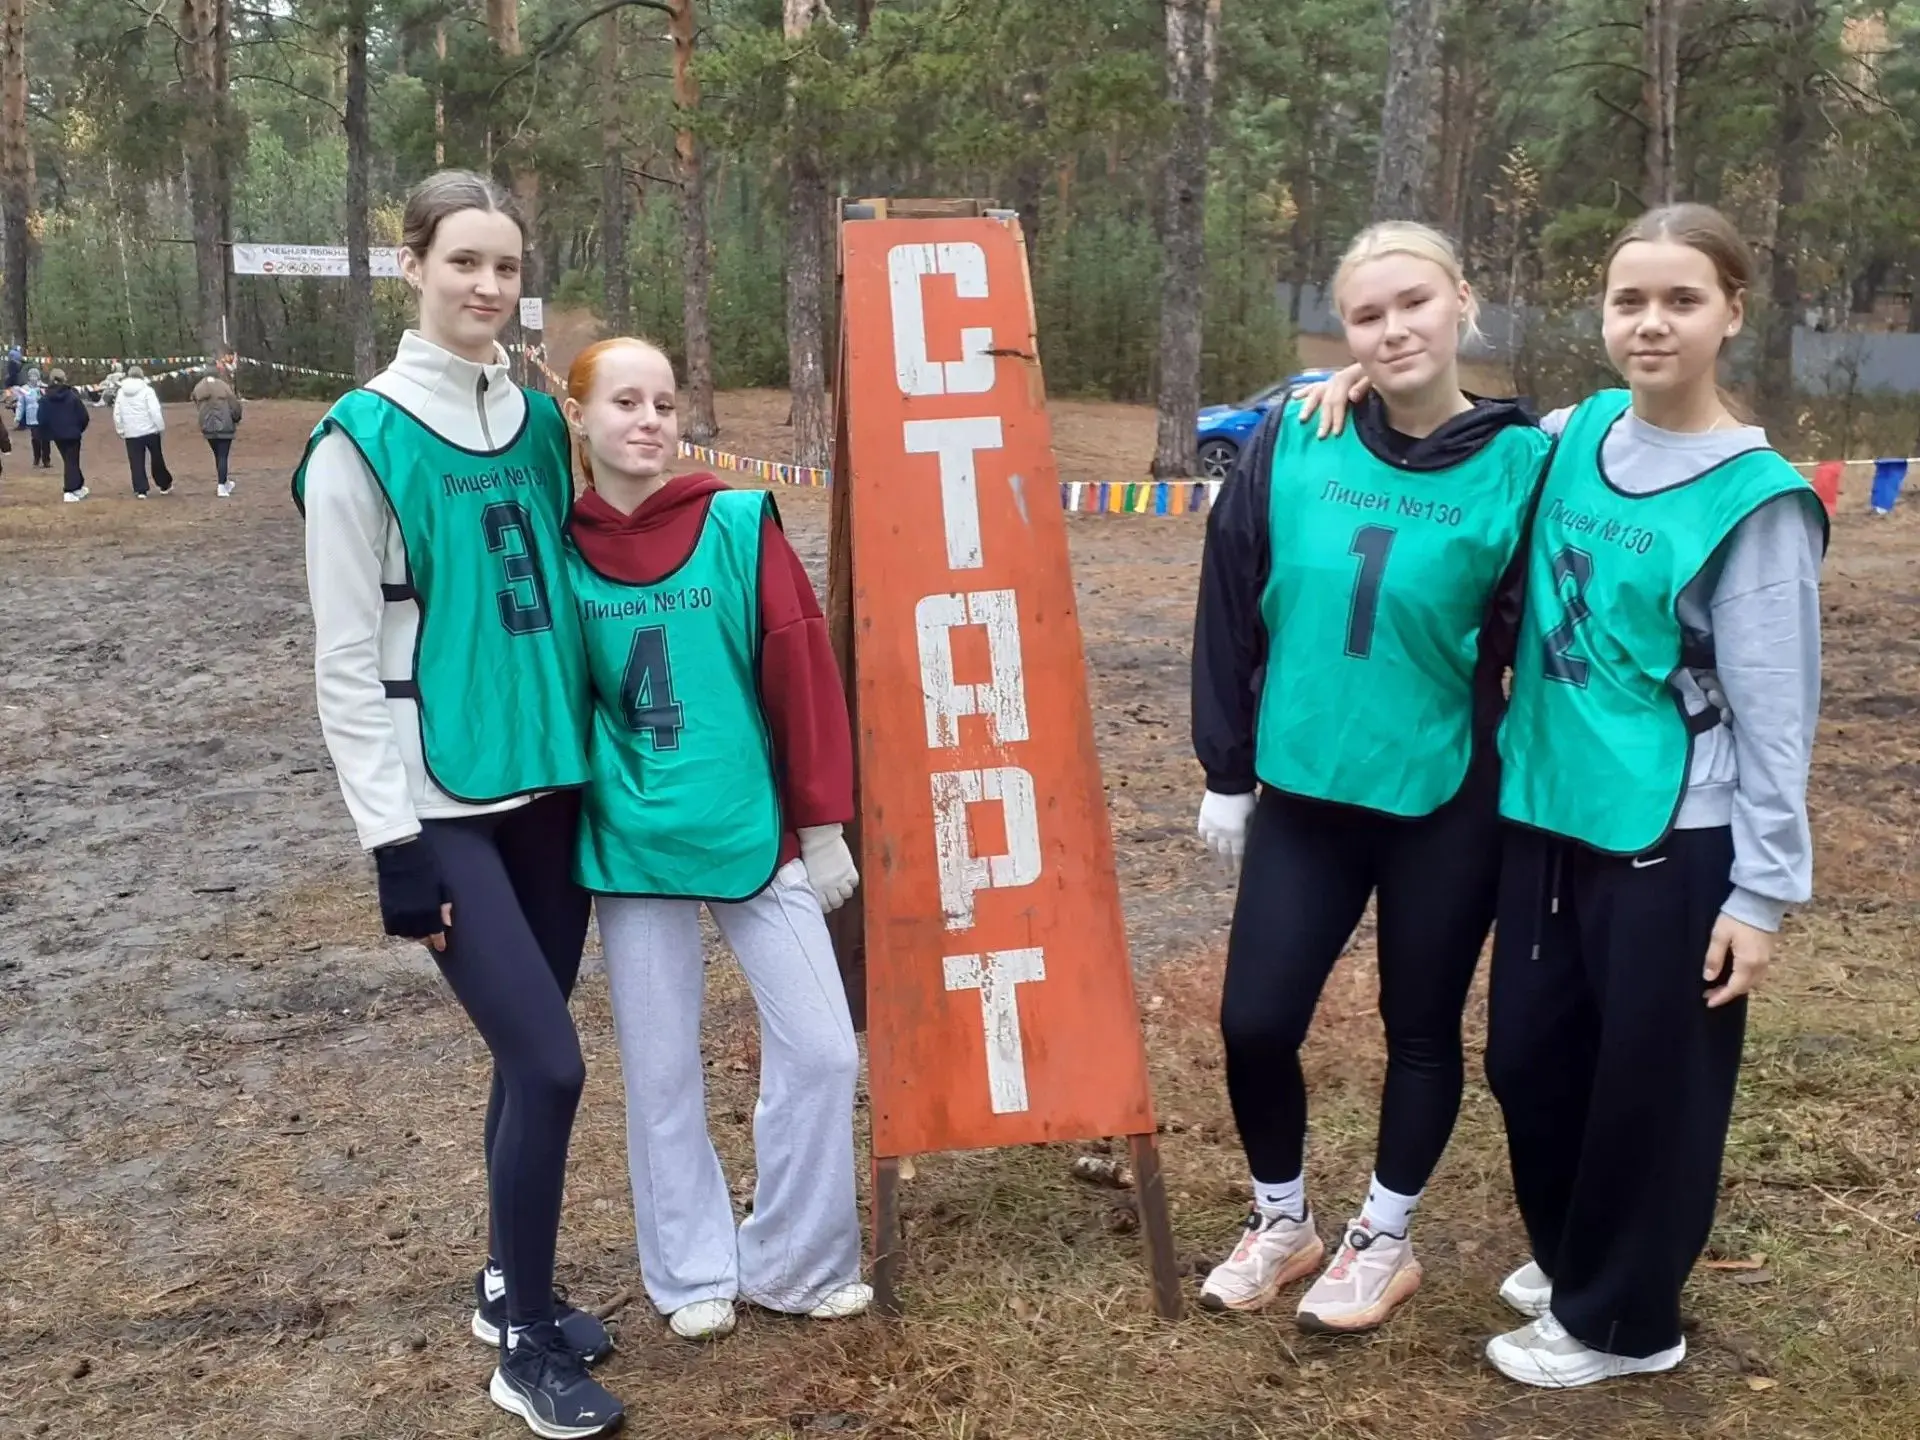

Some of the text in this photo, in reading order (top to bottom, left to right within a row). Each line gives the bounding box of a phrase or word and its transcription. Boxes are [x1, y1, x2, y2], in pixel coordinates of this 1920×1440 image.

[262, 247, 307, 255] УЧЕБНАЯ
[441, 466, 502, 497] Лицей
[1320, 480, 1462, 527] Лицей №130
[1544, 498, 1654, 554] Лицей №130
[480, 500, 553, 636] 3
[583, 586, 712, 621] Лицей №130
[1344, 522, 1398, 660] 1
[1542, 542, 1594, 690] 2
[618, 624, 685, 752] 4
[886, 240, 1047, 1115] СТАРТ
